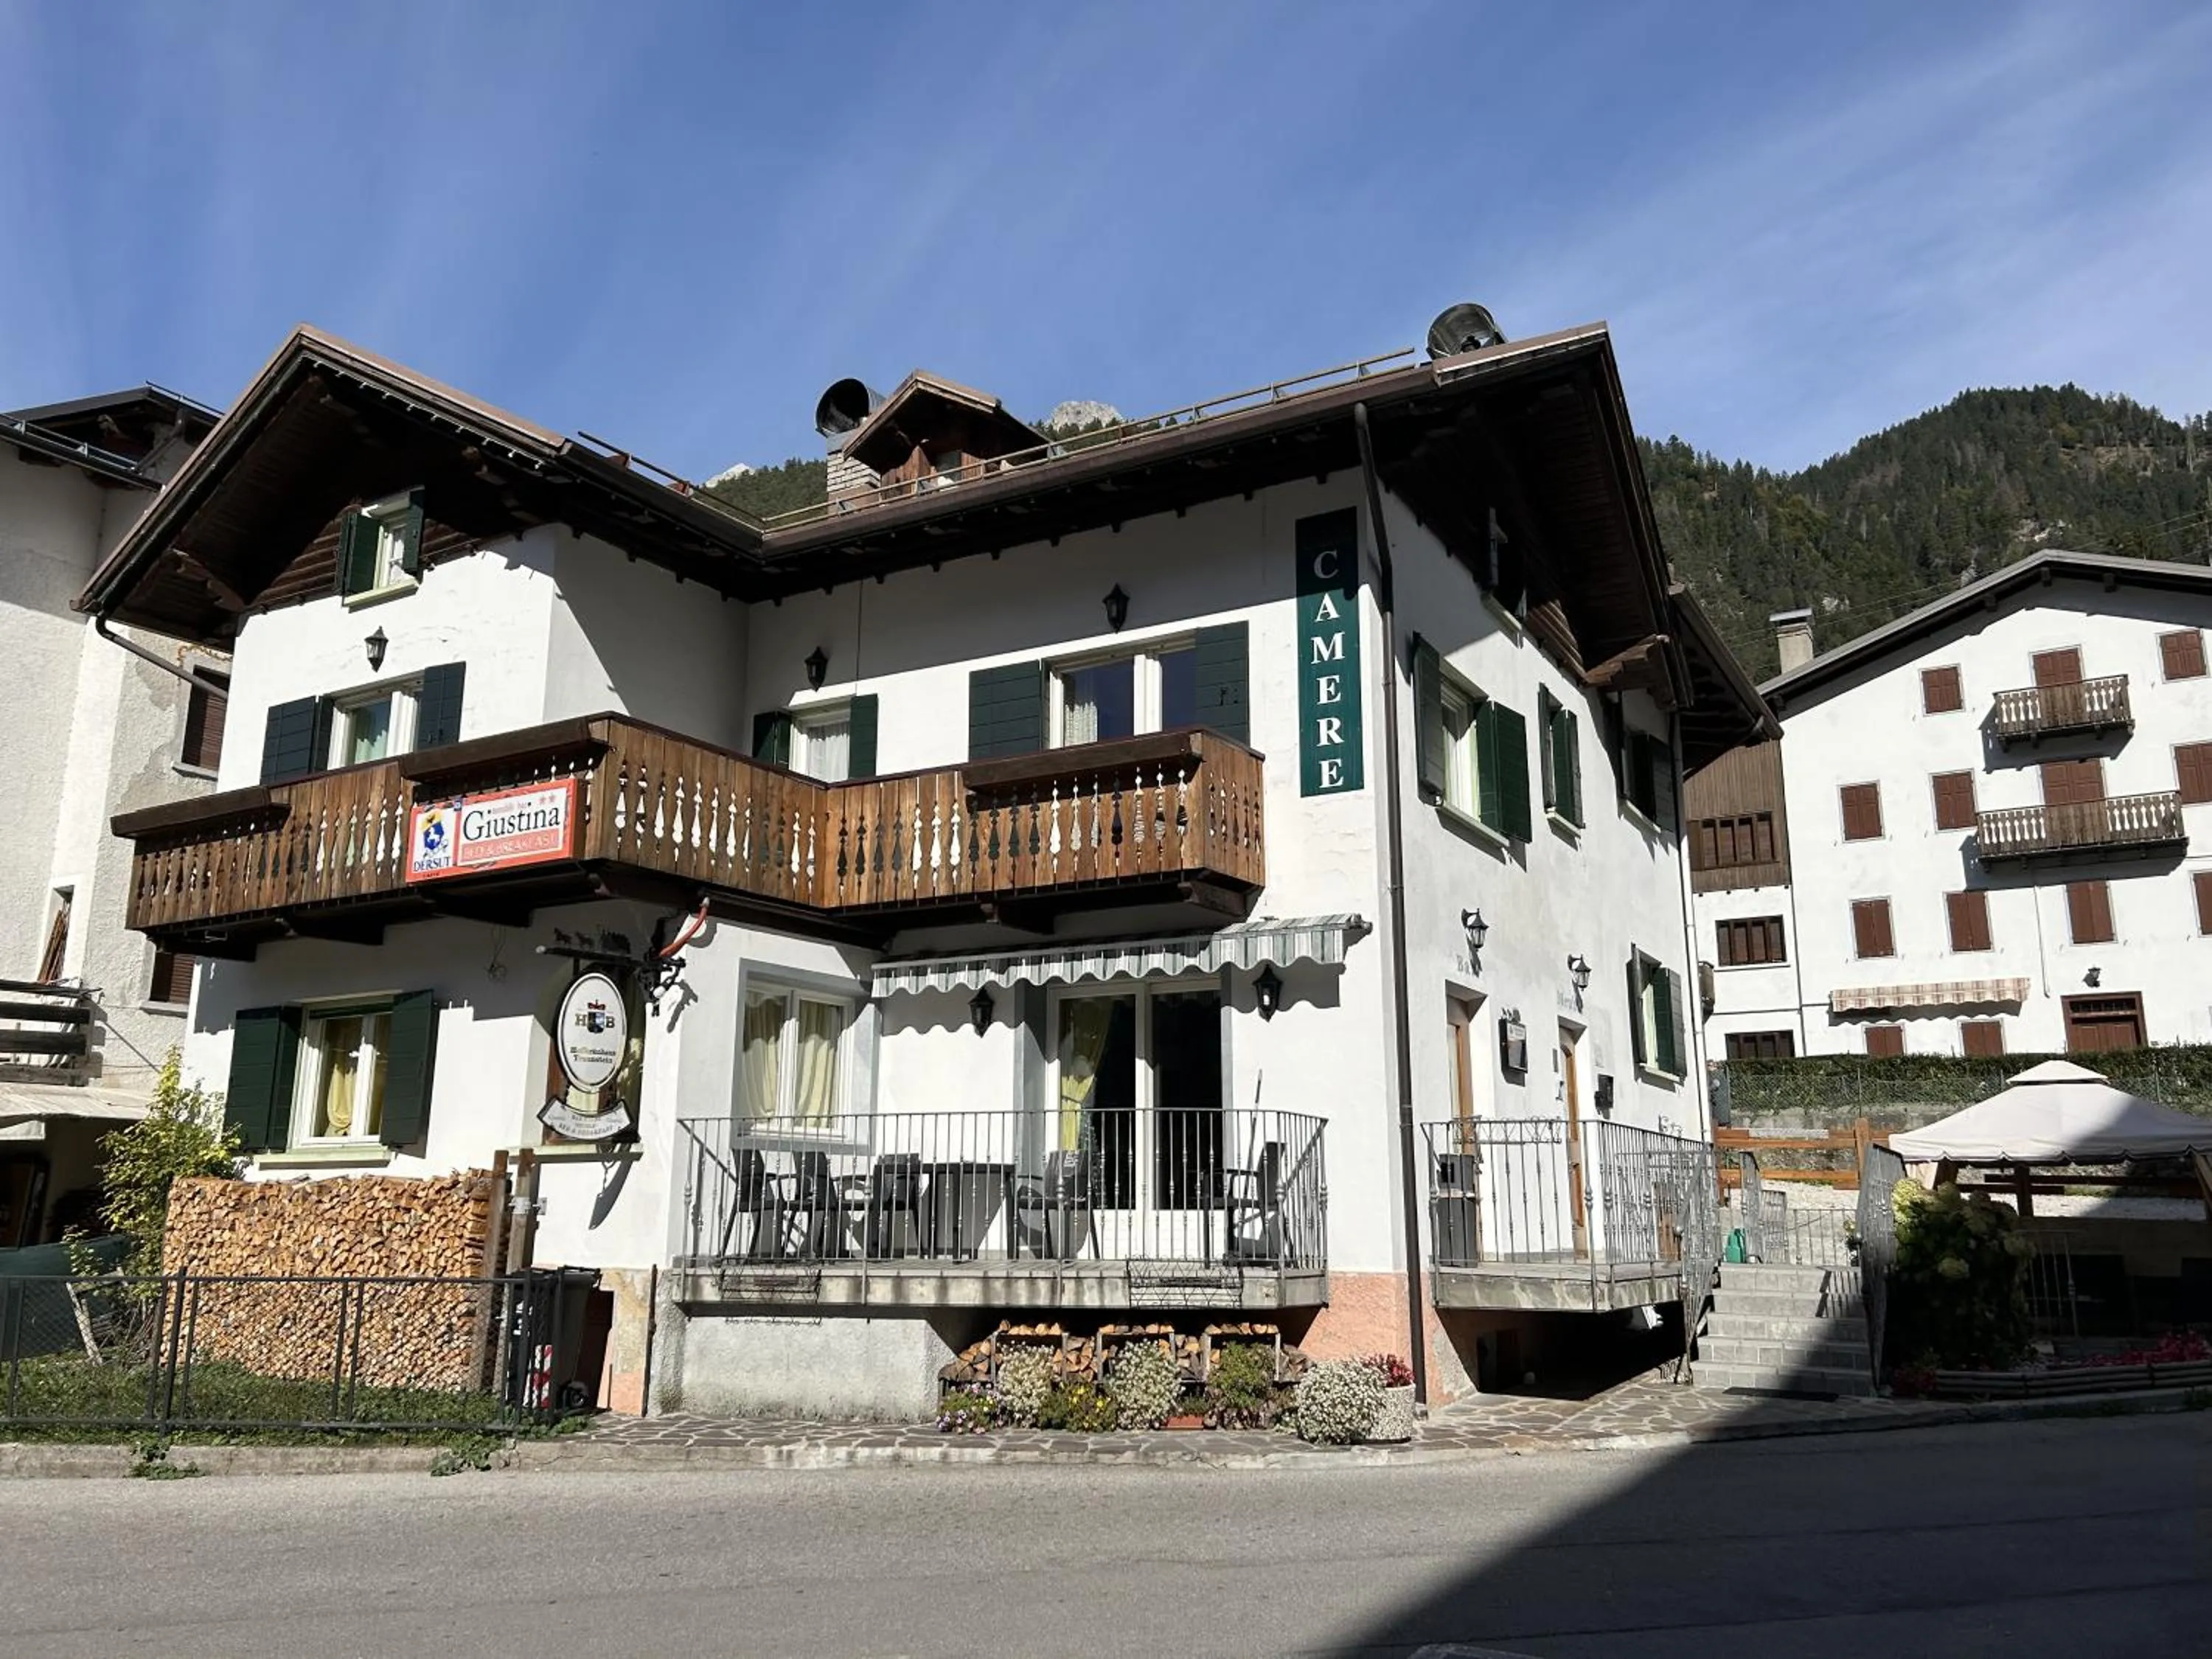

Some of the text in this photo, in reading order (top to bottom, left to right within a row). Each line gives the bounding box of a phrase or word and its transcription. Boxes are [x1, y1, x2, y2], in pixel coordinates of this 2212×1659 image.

[1310, 550, 1346, 789] CAMERE
[463, 801, 561, 841] Giustina
[414, 856, 451, 872] DERSUT
